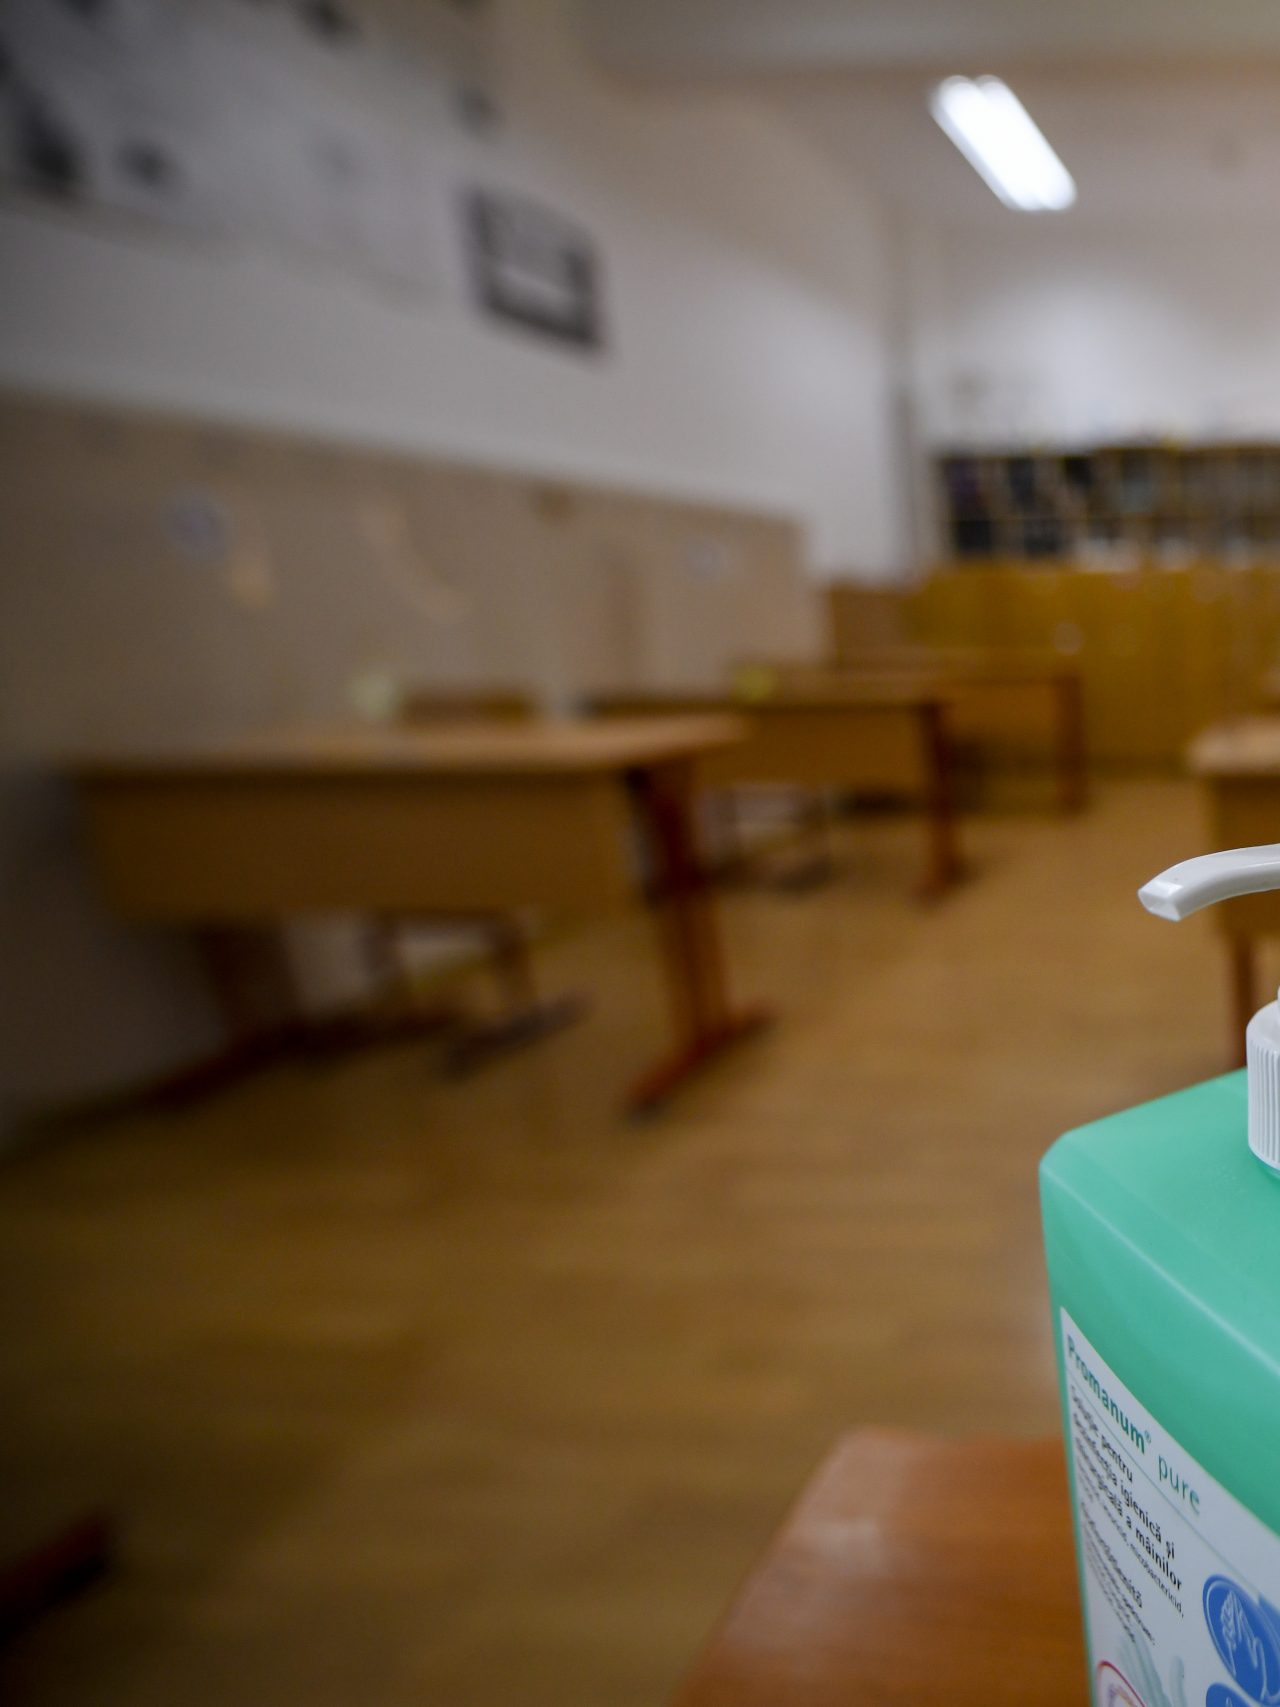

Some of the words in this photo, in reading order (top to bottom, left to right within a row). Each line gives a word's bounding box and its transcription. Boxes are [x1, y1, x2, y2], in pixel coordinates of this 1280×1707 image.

[1101, 1434, 1133, 1482] pentru
[1158, 1455, 1200, 1517] pure
[1120, 1480, 1162, 1543] igienică
[1126, 1516, 1132, 1529] a
[1135, 1528, 1182, 1590] mâinilor
